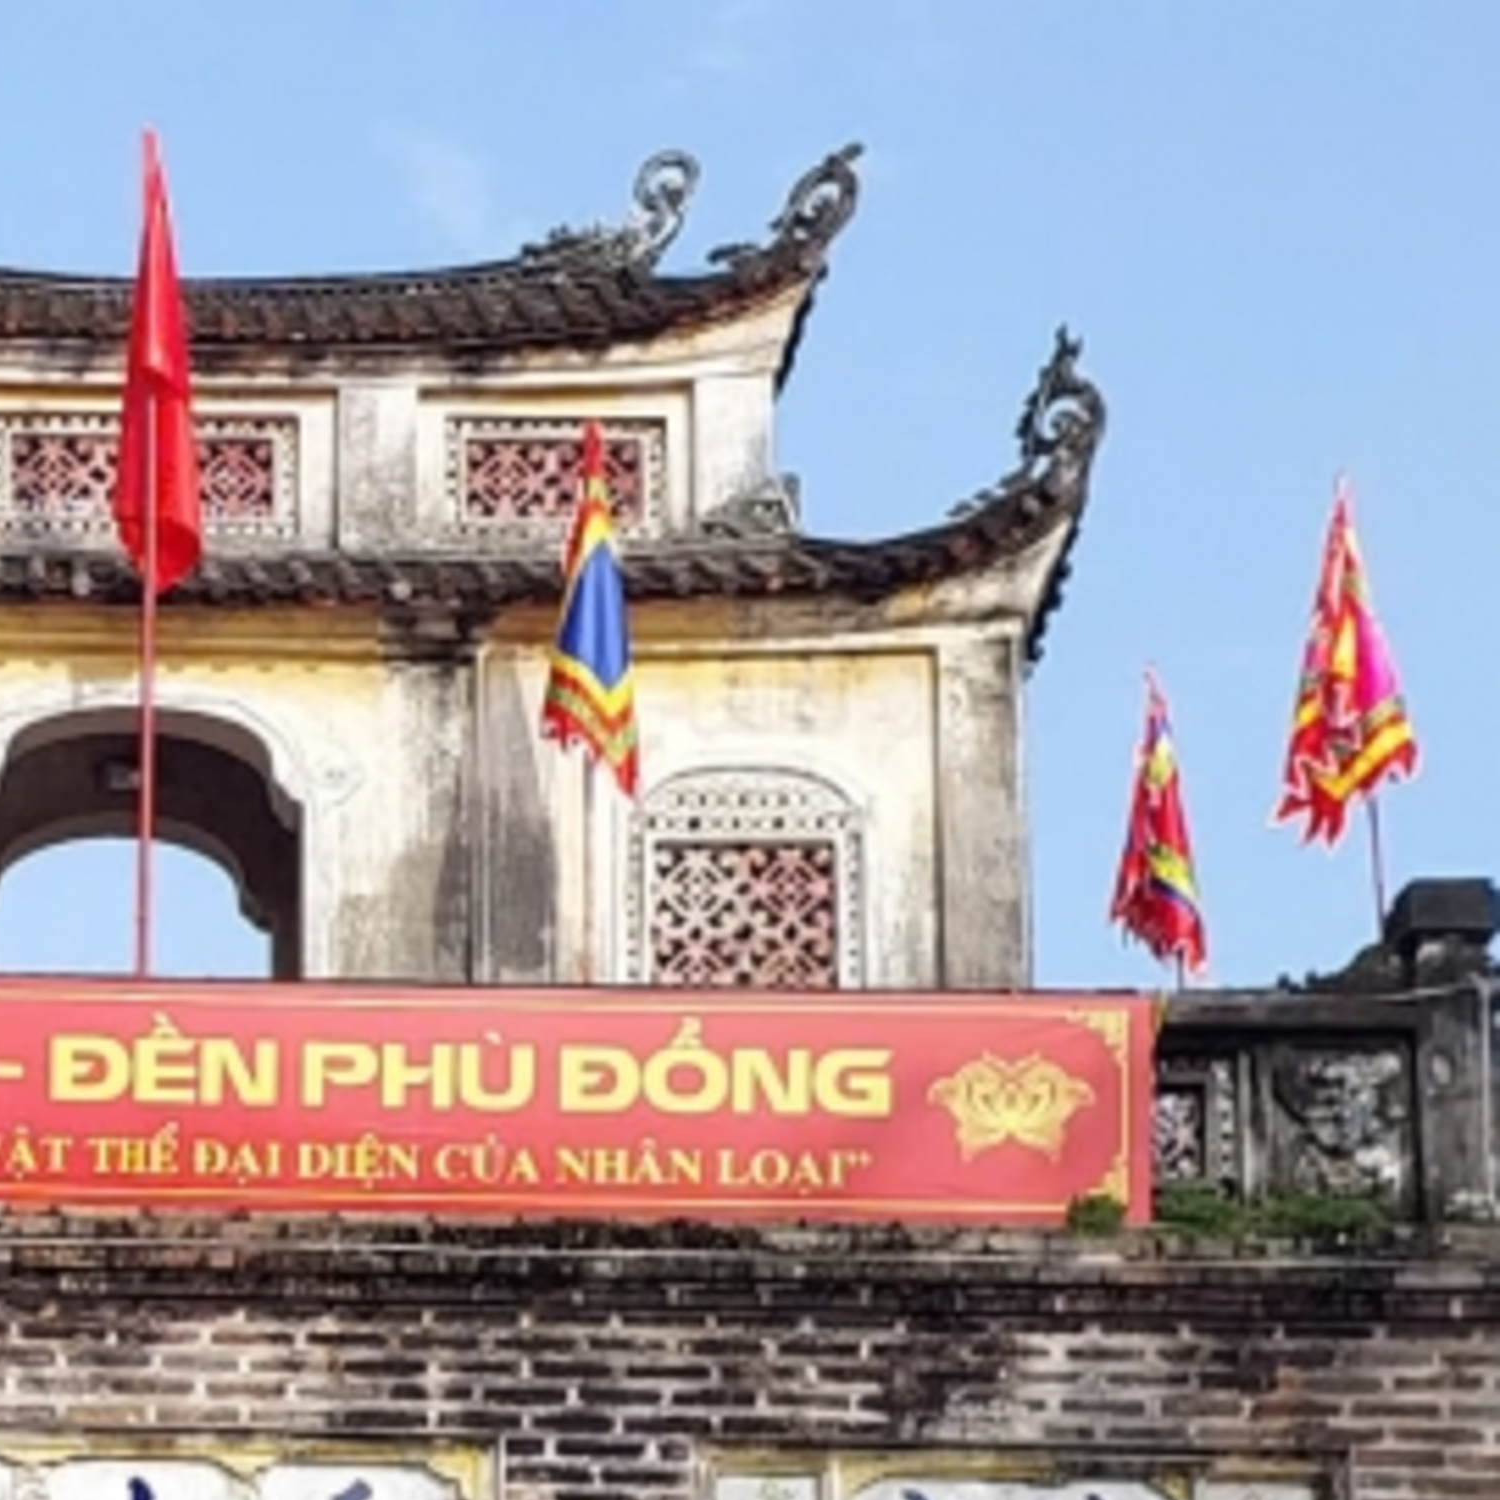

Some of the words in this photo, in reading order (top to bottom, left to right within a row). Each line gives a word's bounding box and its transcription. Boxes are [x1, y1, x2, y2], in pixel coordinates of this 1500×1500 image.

[50, 1011, 279, 1106] ĐỀN
[302, 1030, 536, 1112] PHÙ
[558, 1015, 892, 1118] ĐỔNG
[193, 1141, 280, 1185] ĐẠI
[298, 1132, 420, 1190] DIỆN
[433, 1134, 540, 1182] CỦA
[555, 1137, 702, 1185] NHÂN
